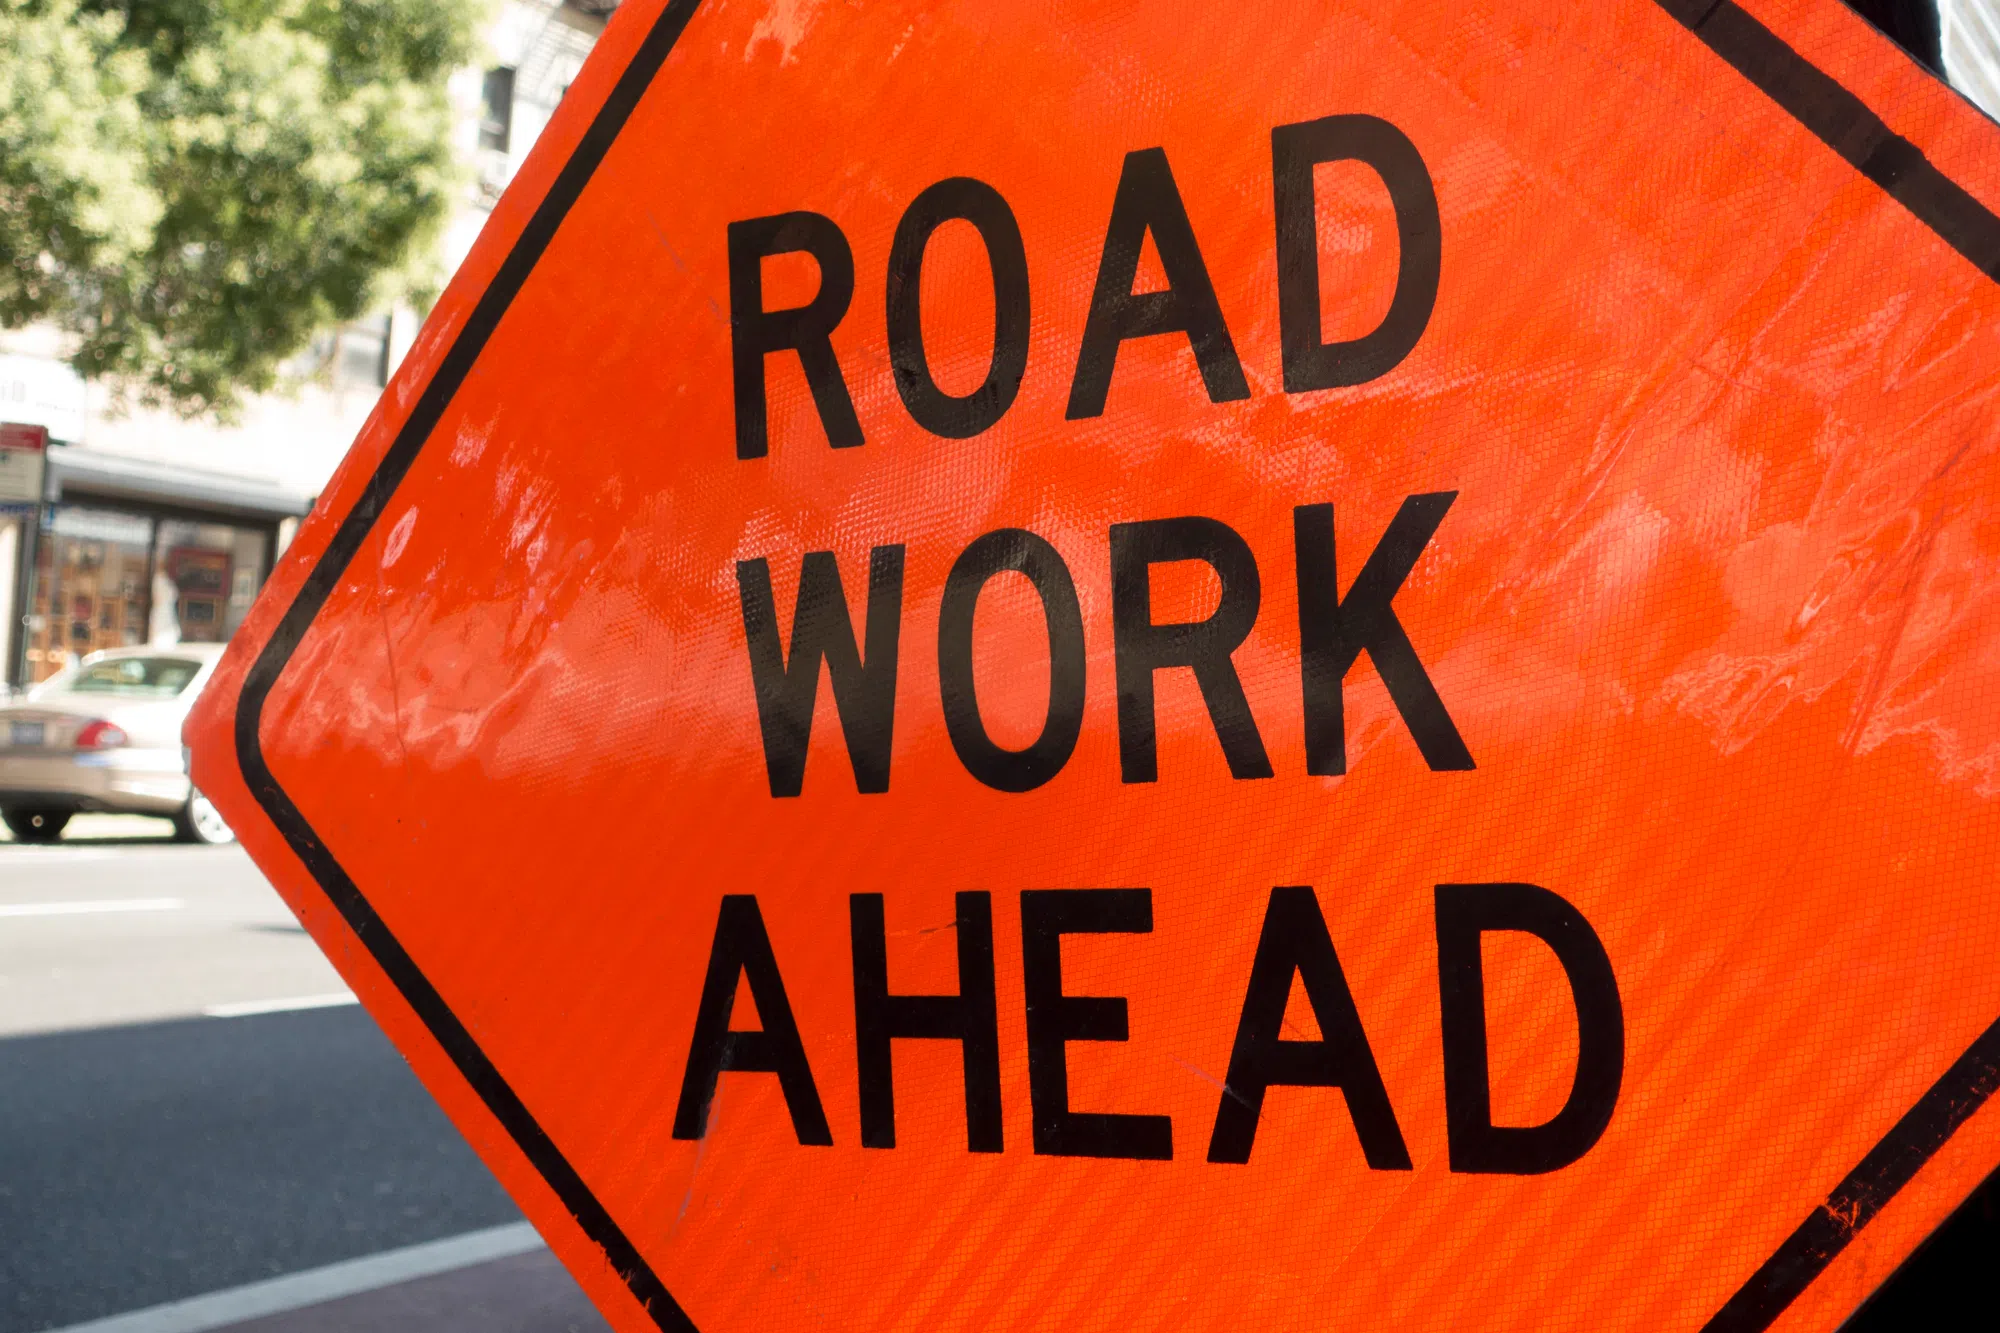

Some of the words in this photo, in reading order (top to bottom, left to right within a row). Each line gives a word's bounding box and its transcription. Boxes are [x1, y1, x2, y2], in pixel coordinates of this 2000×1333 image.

[728, 114, 1441, 461] ROAD
[736, 490, 1477, 799] WORK
[672, 882, 1625, 1175] AHEAD
